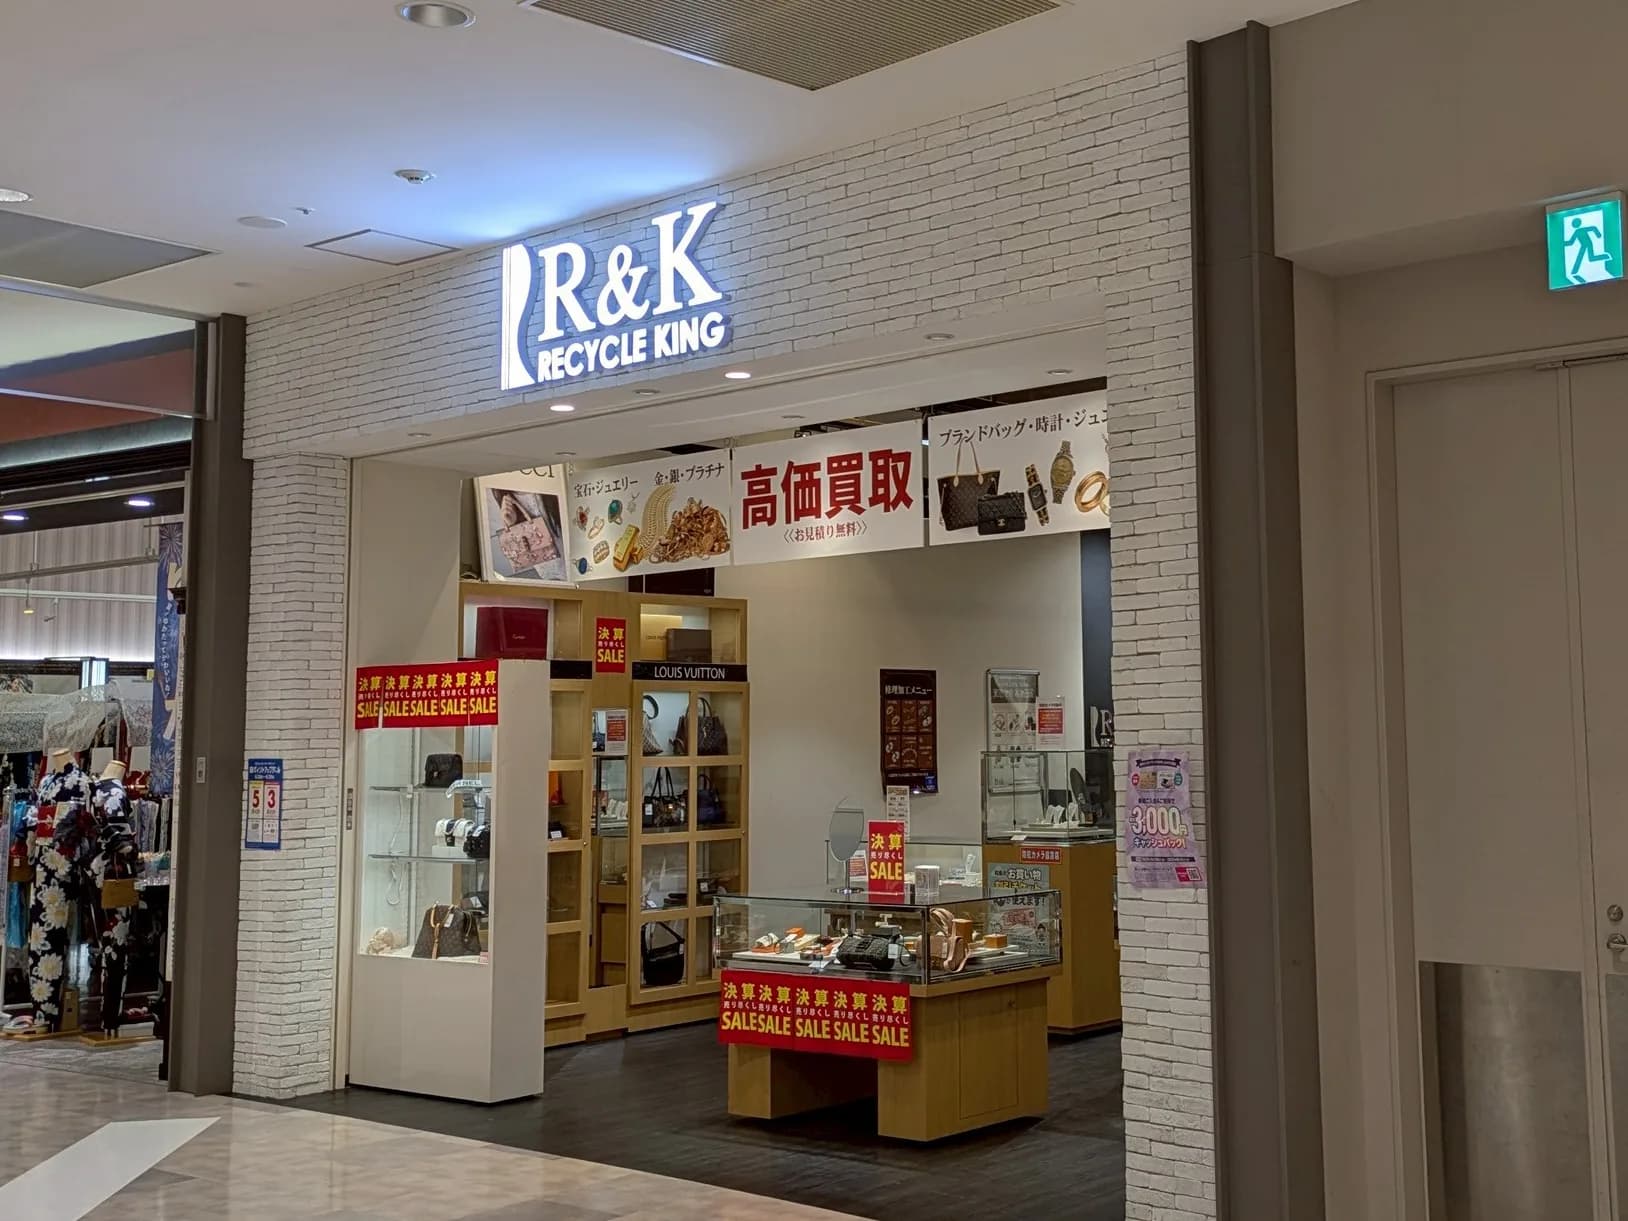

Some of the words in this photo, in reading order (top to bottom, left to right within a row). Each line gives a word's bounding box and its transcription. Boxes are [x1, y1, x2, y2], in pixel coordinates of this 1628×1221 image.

[538, 201, 723, 342] R&K
[537, 328, 647, 383] RECYCLE
[654, 311, 725, 358] KING
[654, 462, 725, 486] 金・銀・プラチナ
[574, 477, 638, 498] 宝石・ジュエリー
[740, 448, 914, 530] 高価買取
[598, 626, 625, 640] 決算
[597, 649, 625, 663] SALE
[385, 675, 410, 690] 決算
[413, 674, 438, 689] 決算
[441, 672, 467, 688] 決算
[470, 670, 497, 686] 決算
[654, 666, 683, 679] LOUIS
[684, 667, 726, 680] VUITTON
[357, 701, 379, 718] SALE
[383, 701, 409, 717] SALE
[410, 700, 438, 717] SALE
[440, 698, 467, 716] SALE
[469, 697, 497, 714] SALE
[252, 789, 260, 808] 5
[267, 789, 276, 808] 3
[871, 833, 903, 850] 決算
[871, 851, 903, 860] 売り尽くし
[870, 861, 903, 881] SALE
[723, 982, 756, 1000] 決算
[759, 984, 791, 1004] 決算
[795, 987, 830, 1008] 決算
[833, 990, 868, 1011] 決算
[872, 994, 908, 1015] 決算
[721, 1011, 757, 1030] SALE
[758, 1013, 792, 1035] SALE
[795, 1018, 831, 1039] SALE
[833, 1021, 870, 1043] SALE
[872, 1024, 910, 1047] SALE
